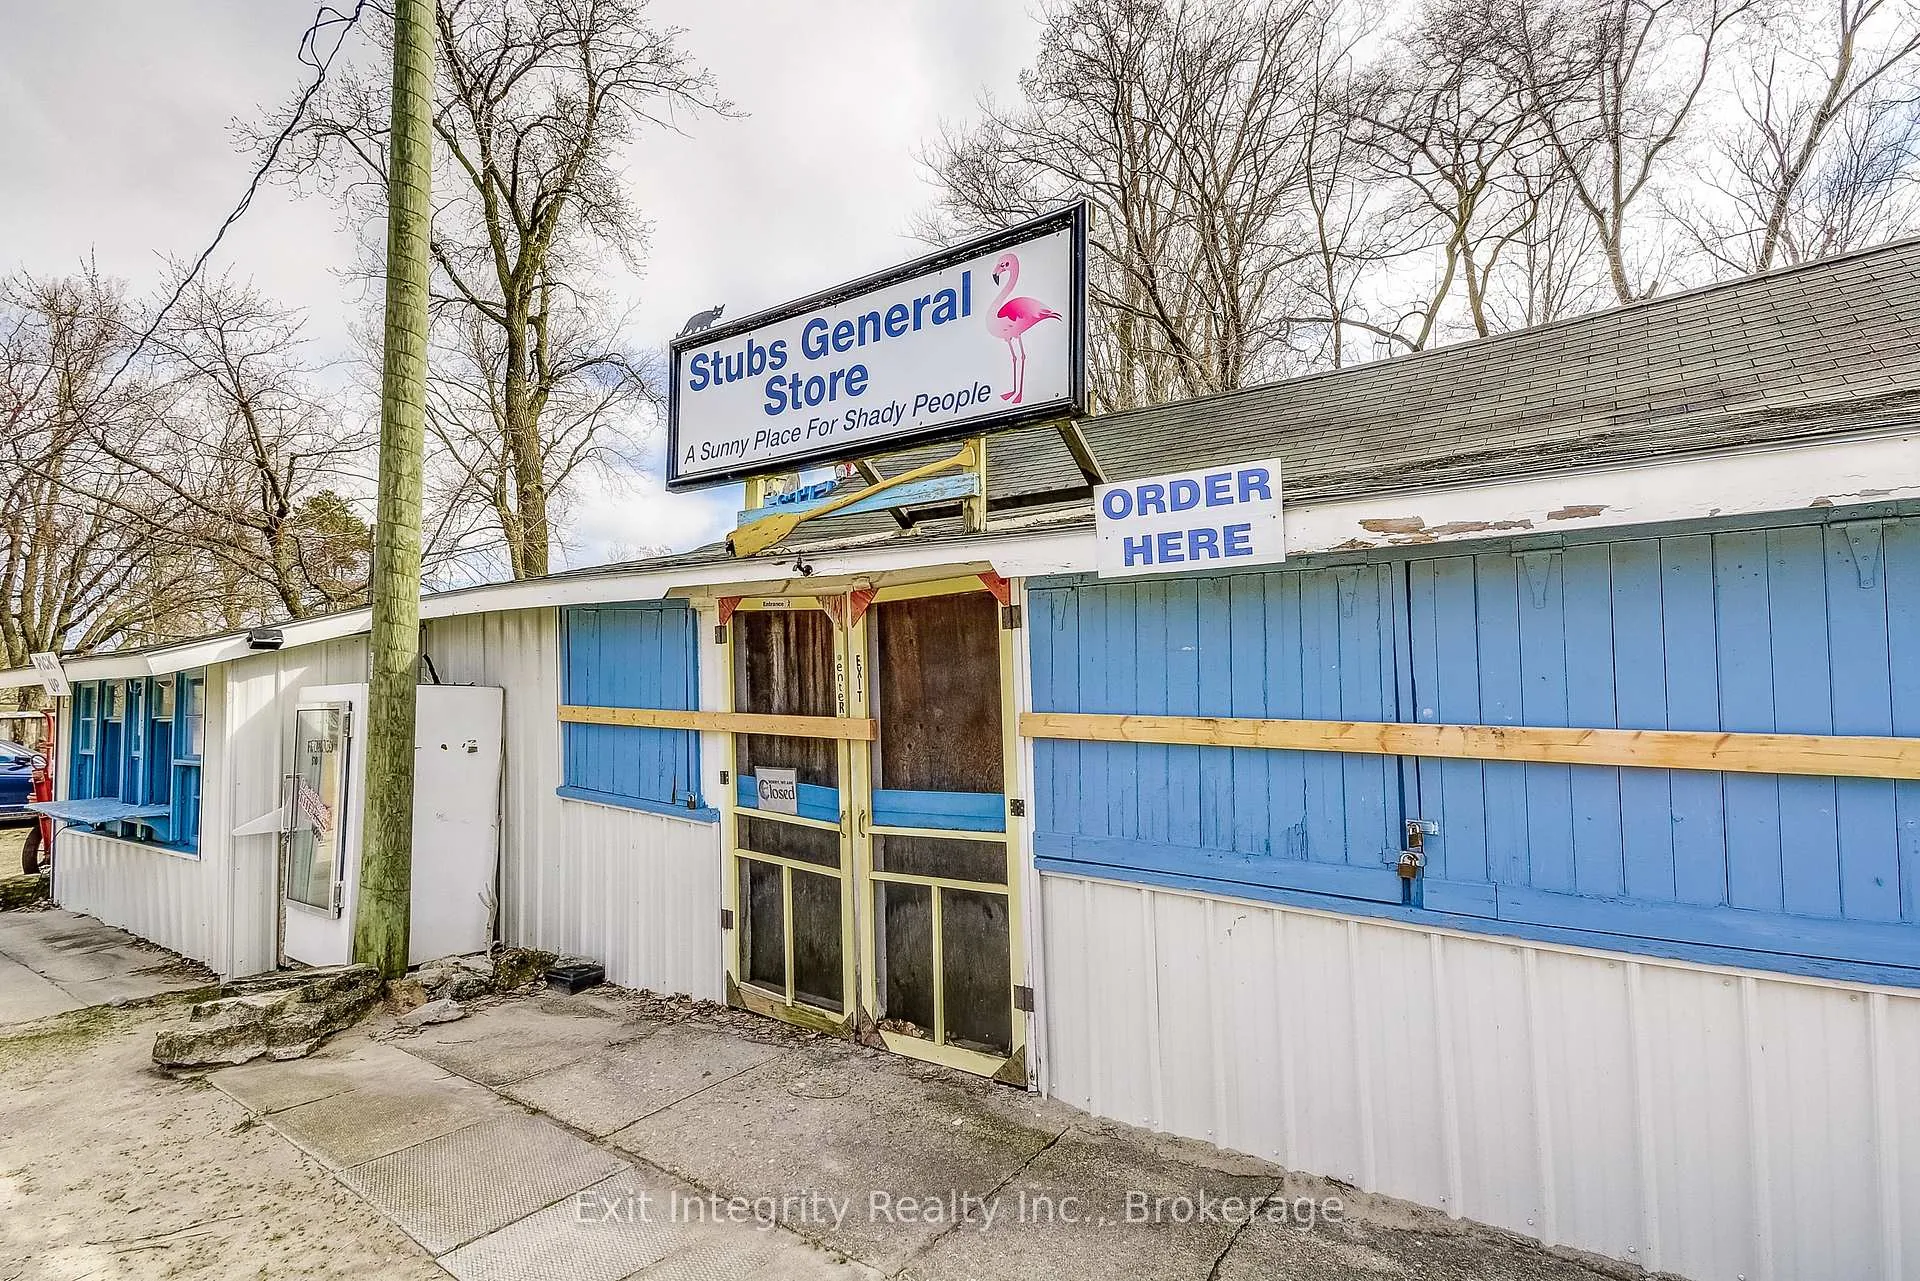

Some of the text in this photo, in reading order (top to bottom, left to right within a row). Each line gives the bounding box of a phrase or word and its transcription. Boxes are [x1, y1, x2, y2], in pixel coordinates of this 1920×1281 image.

[689, 270, 972, 392] Stubs General
[764, 363, 869, 416] Store
[684, 381, 992, 465] A Sunny Place For Shady People
[1102, 467, 1273, 521] ORDER
[1123, 522, 1254, 568] HERE
[855, 654, 863, 703] EXIT
[758, 779, 796, 800] Closed
